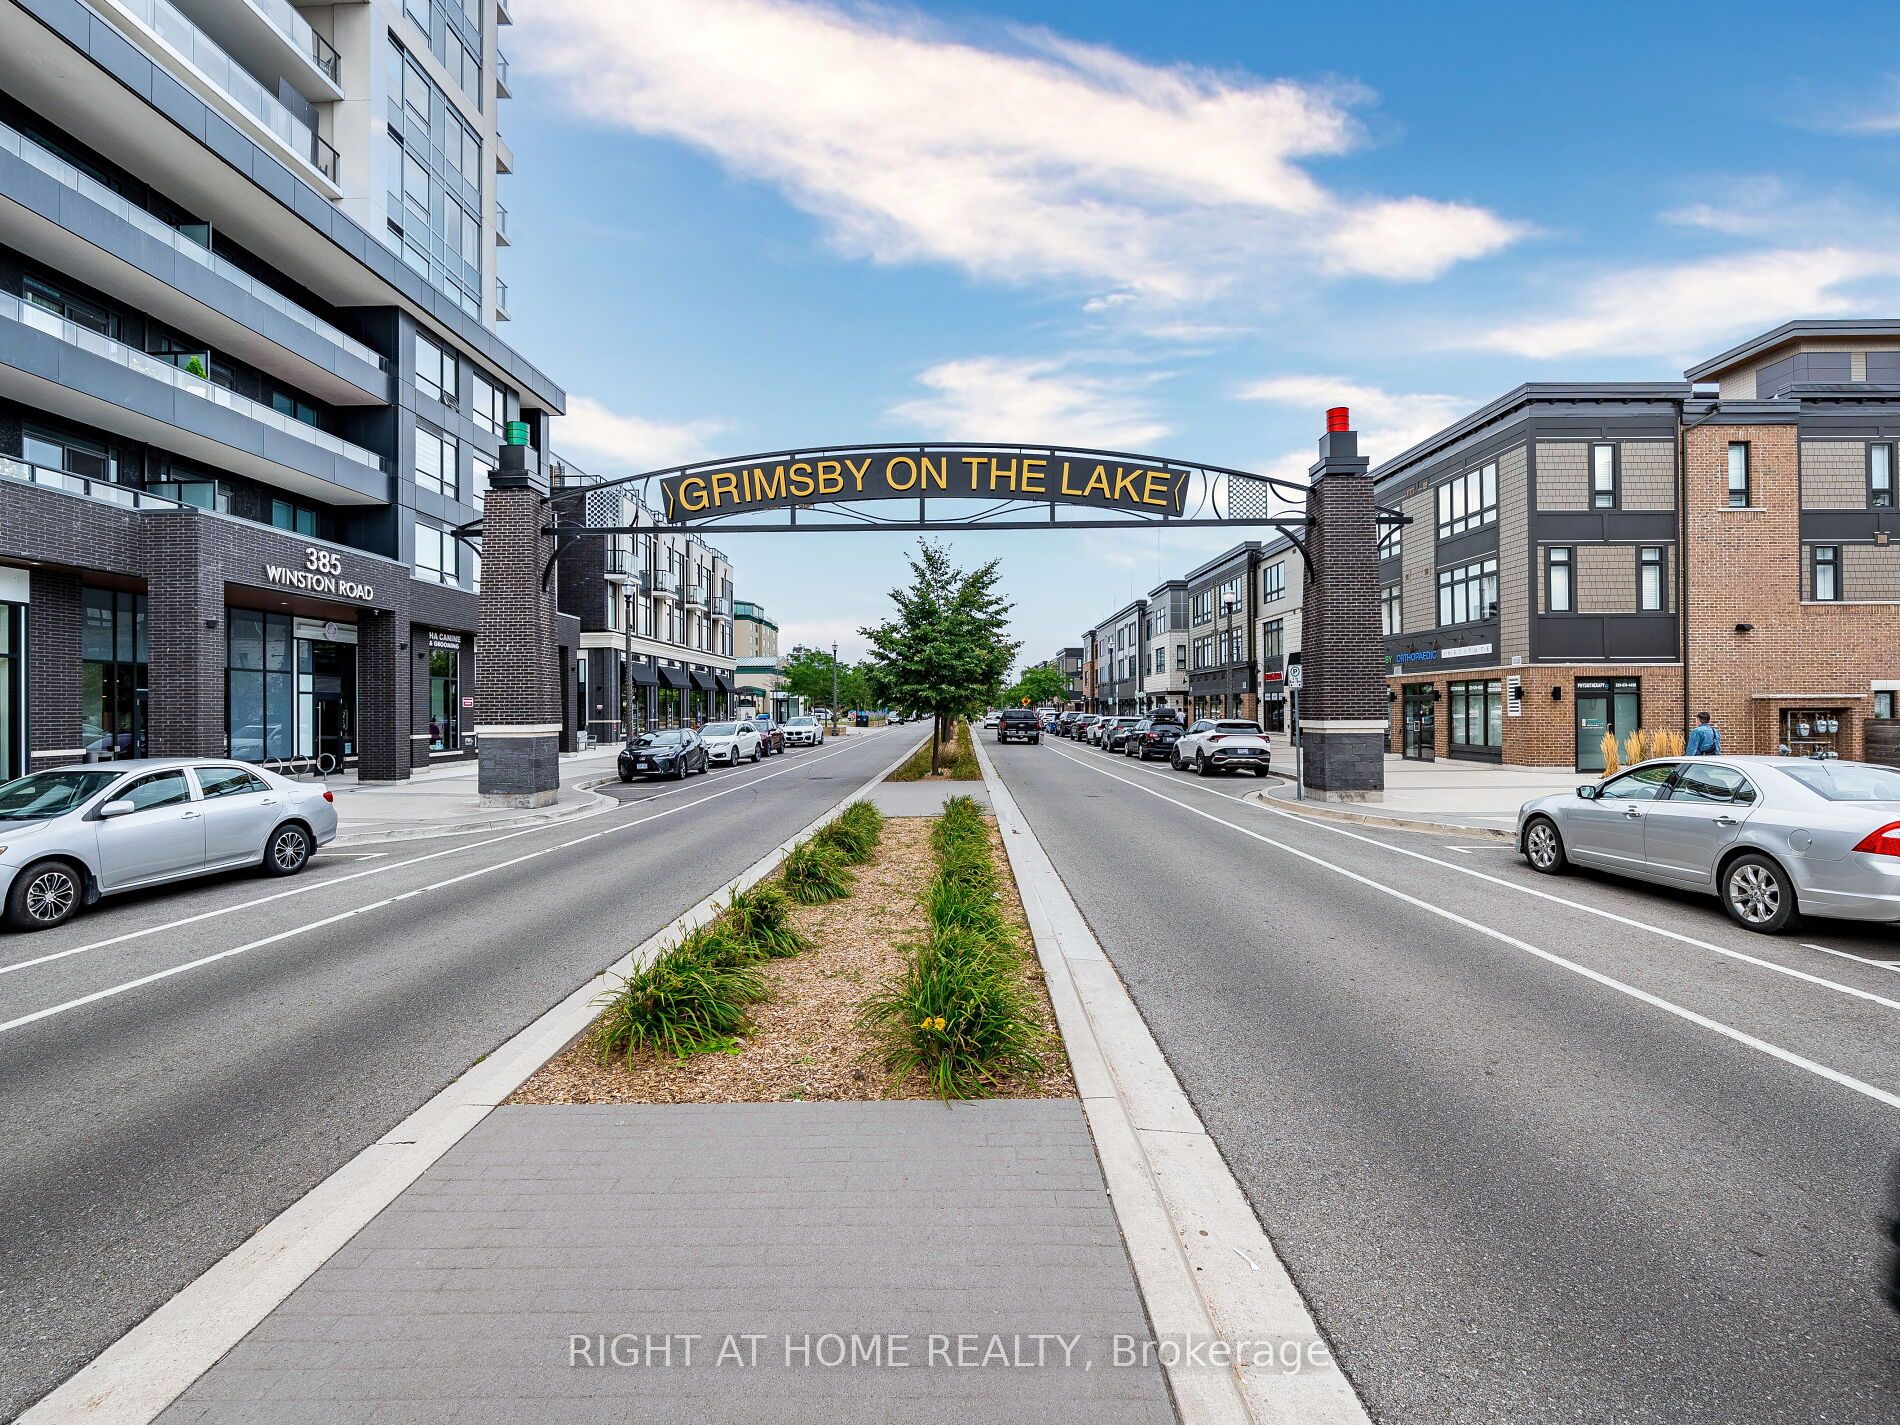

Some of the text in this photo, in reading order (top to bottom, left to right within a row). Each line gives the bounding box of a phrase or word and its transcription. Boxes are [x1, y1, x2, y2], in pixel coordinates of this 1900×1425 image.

[678, 456, 1171, 511] GRIMSBY ON THE LAKE
[305, 547, 342, 575] 385
[266, 564, 374, 600] WINSTON ROAD
[433, 640, 460, 649] GROOMING
[439, 633, 461, 643] CANINE
[1396, 645, 1437, 663] ORTHOPAEDIC
[1443, 645, 1491, 657] INSTITUTE
